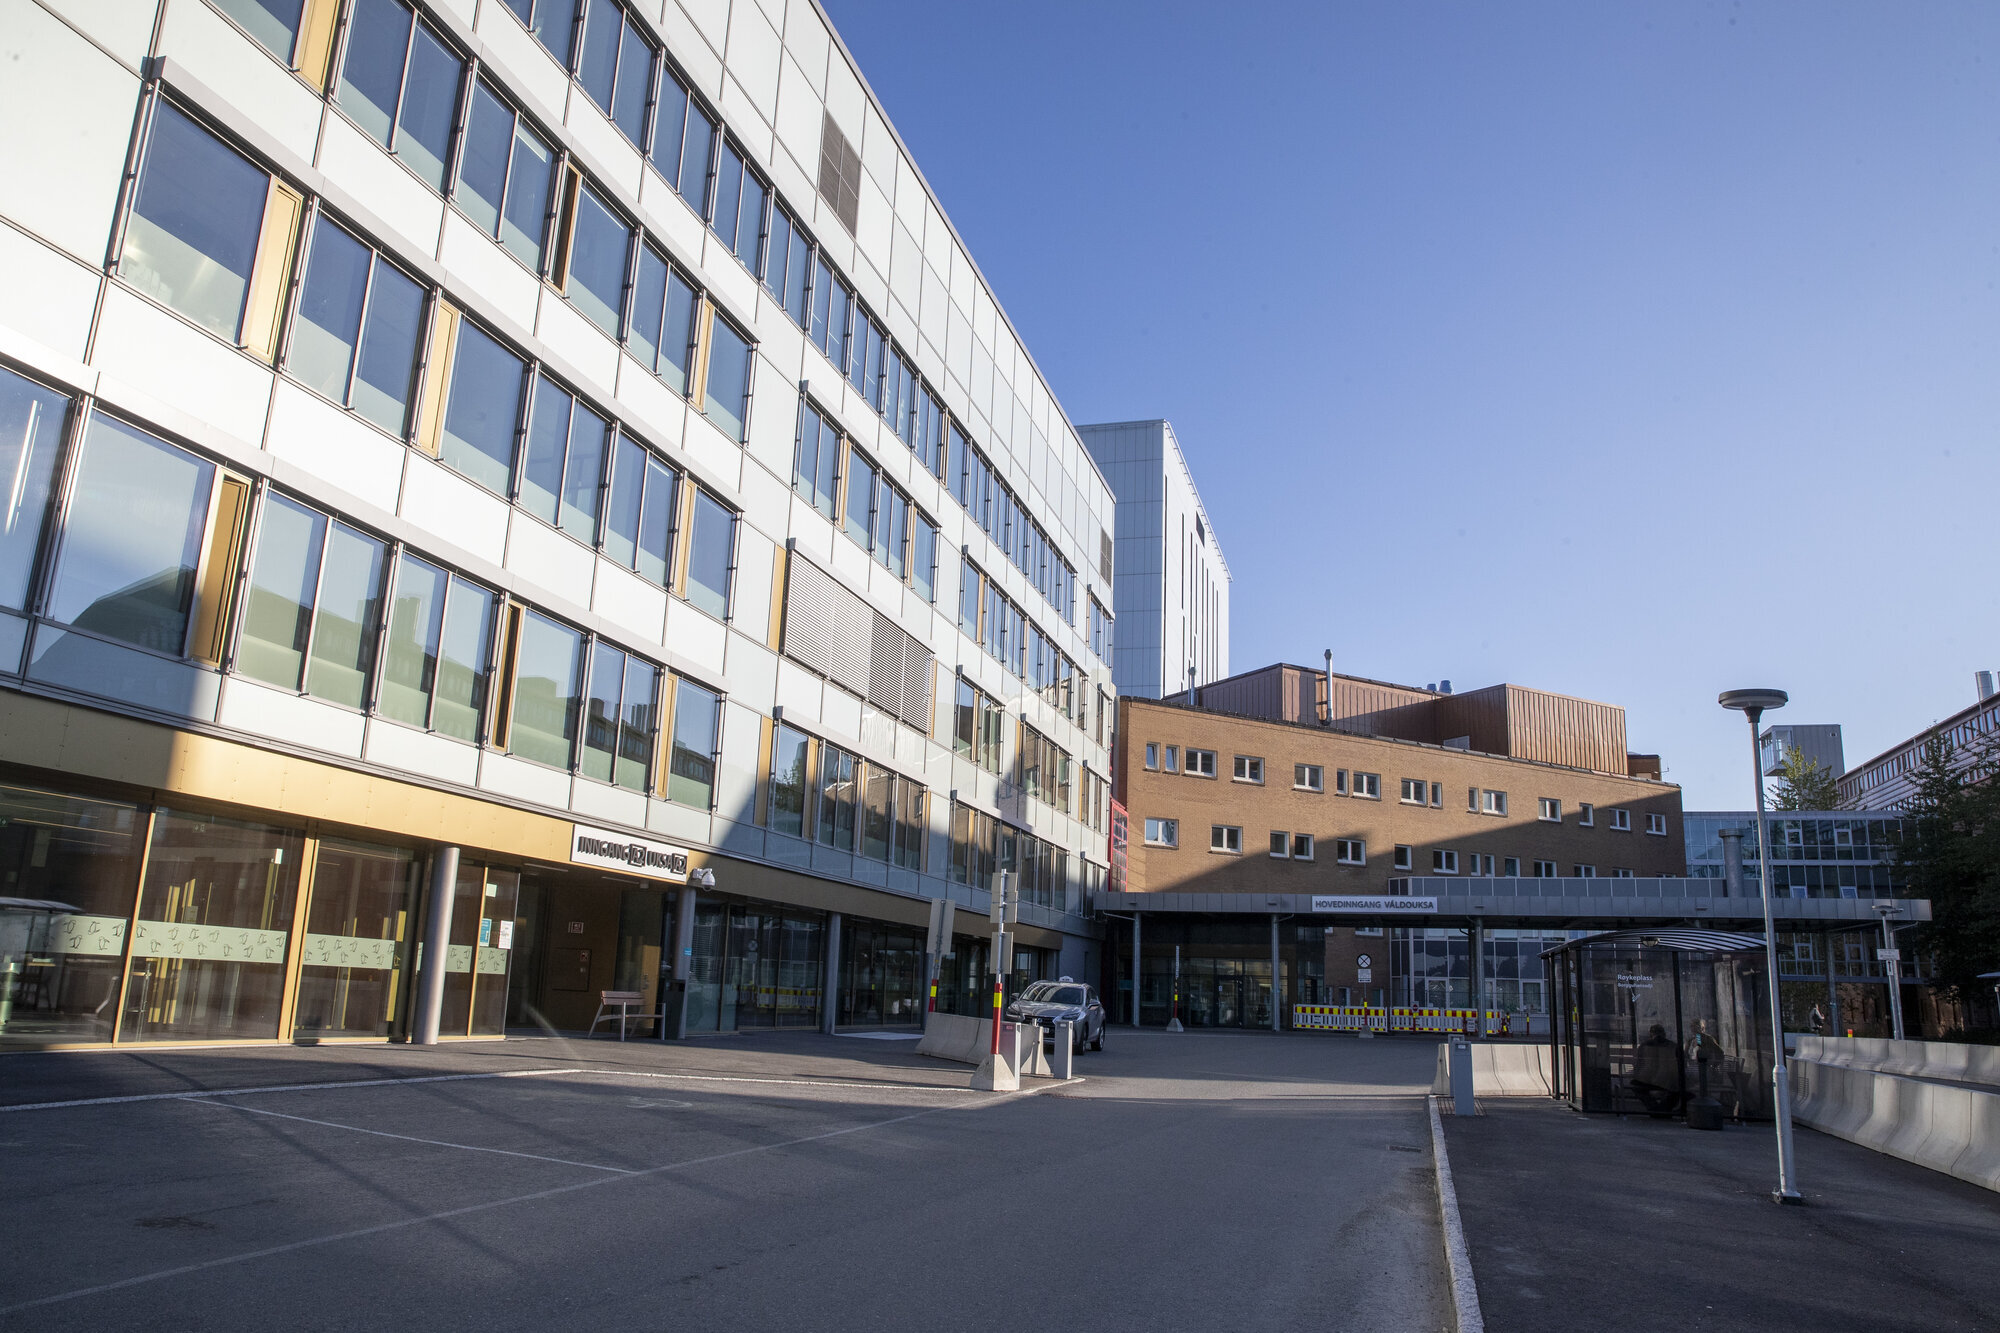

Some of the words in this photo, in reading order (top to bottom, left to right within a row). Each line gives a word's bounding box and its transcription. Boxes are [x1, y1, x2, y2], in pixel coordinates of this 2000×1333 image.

[578, 836, 630, 861] INNGANG
[629, 845, 646, 866] A2
[646, 851, 672, 869] UKSA
[671, 854, 687, 874] A2
[1315, 901, 1381, 909] HOVEDINNGANG
